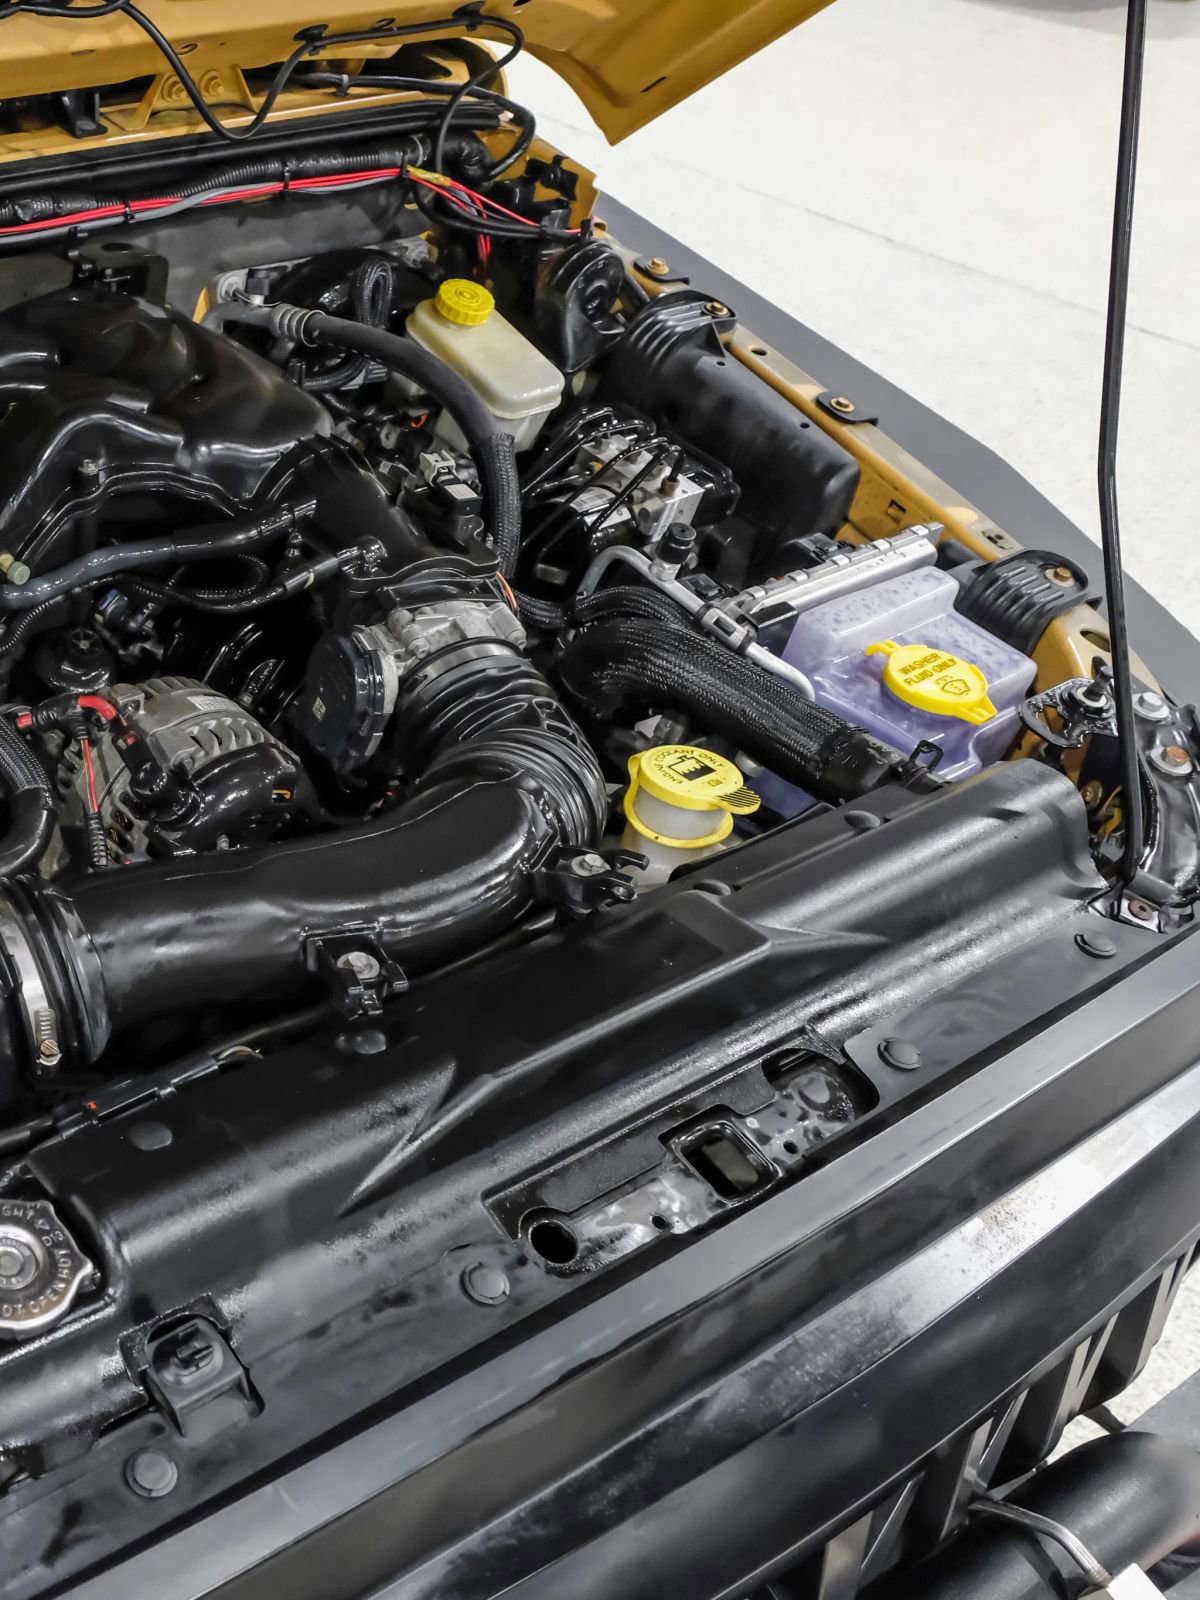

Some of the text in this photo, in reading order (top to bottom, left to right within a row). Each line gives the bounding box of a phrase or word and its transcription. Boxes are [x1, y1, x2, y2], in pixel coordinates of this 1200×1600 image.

[898, 653, 942, 675] WASHER
[904, 657, 958, 686] FLUID ONLY
[654, 748, 725, 784] ENGINE COOLANT ONLY
[29, 1280, 66, 1313] OPEN
[57, 1250, 72, 1279] HOT
